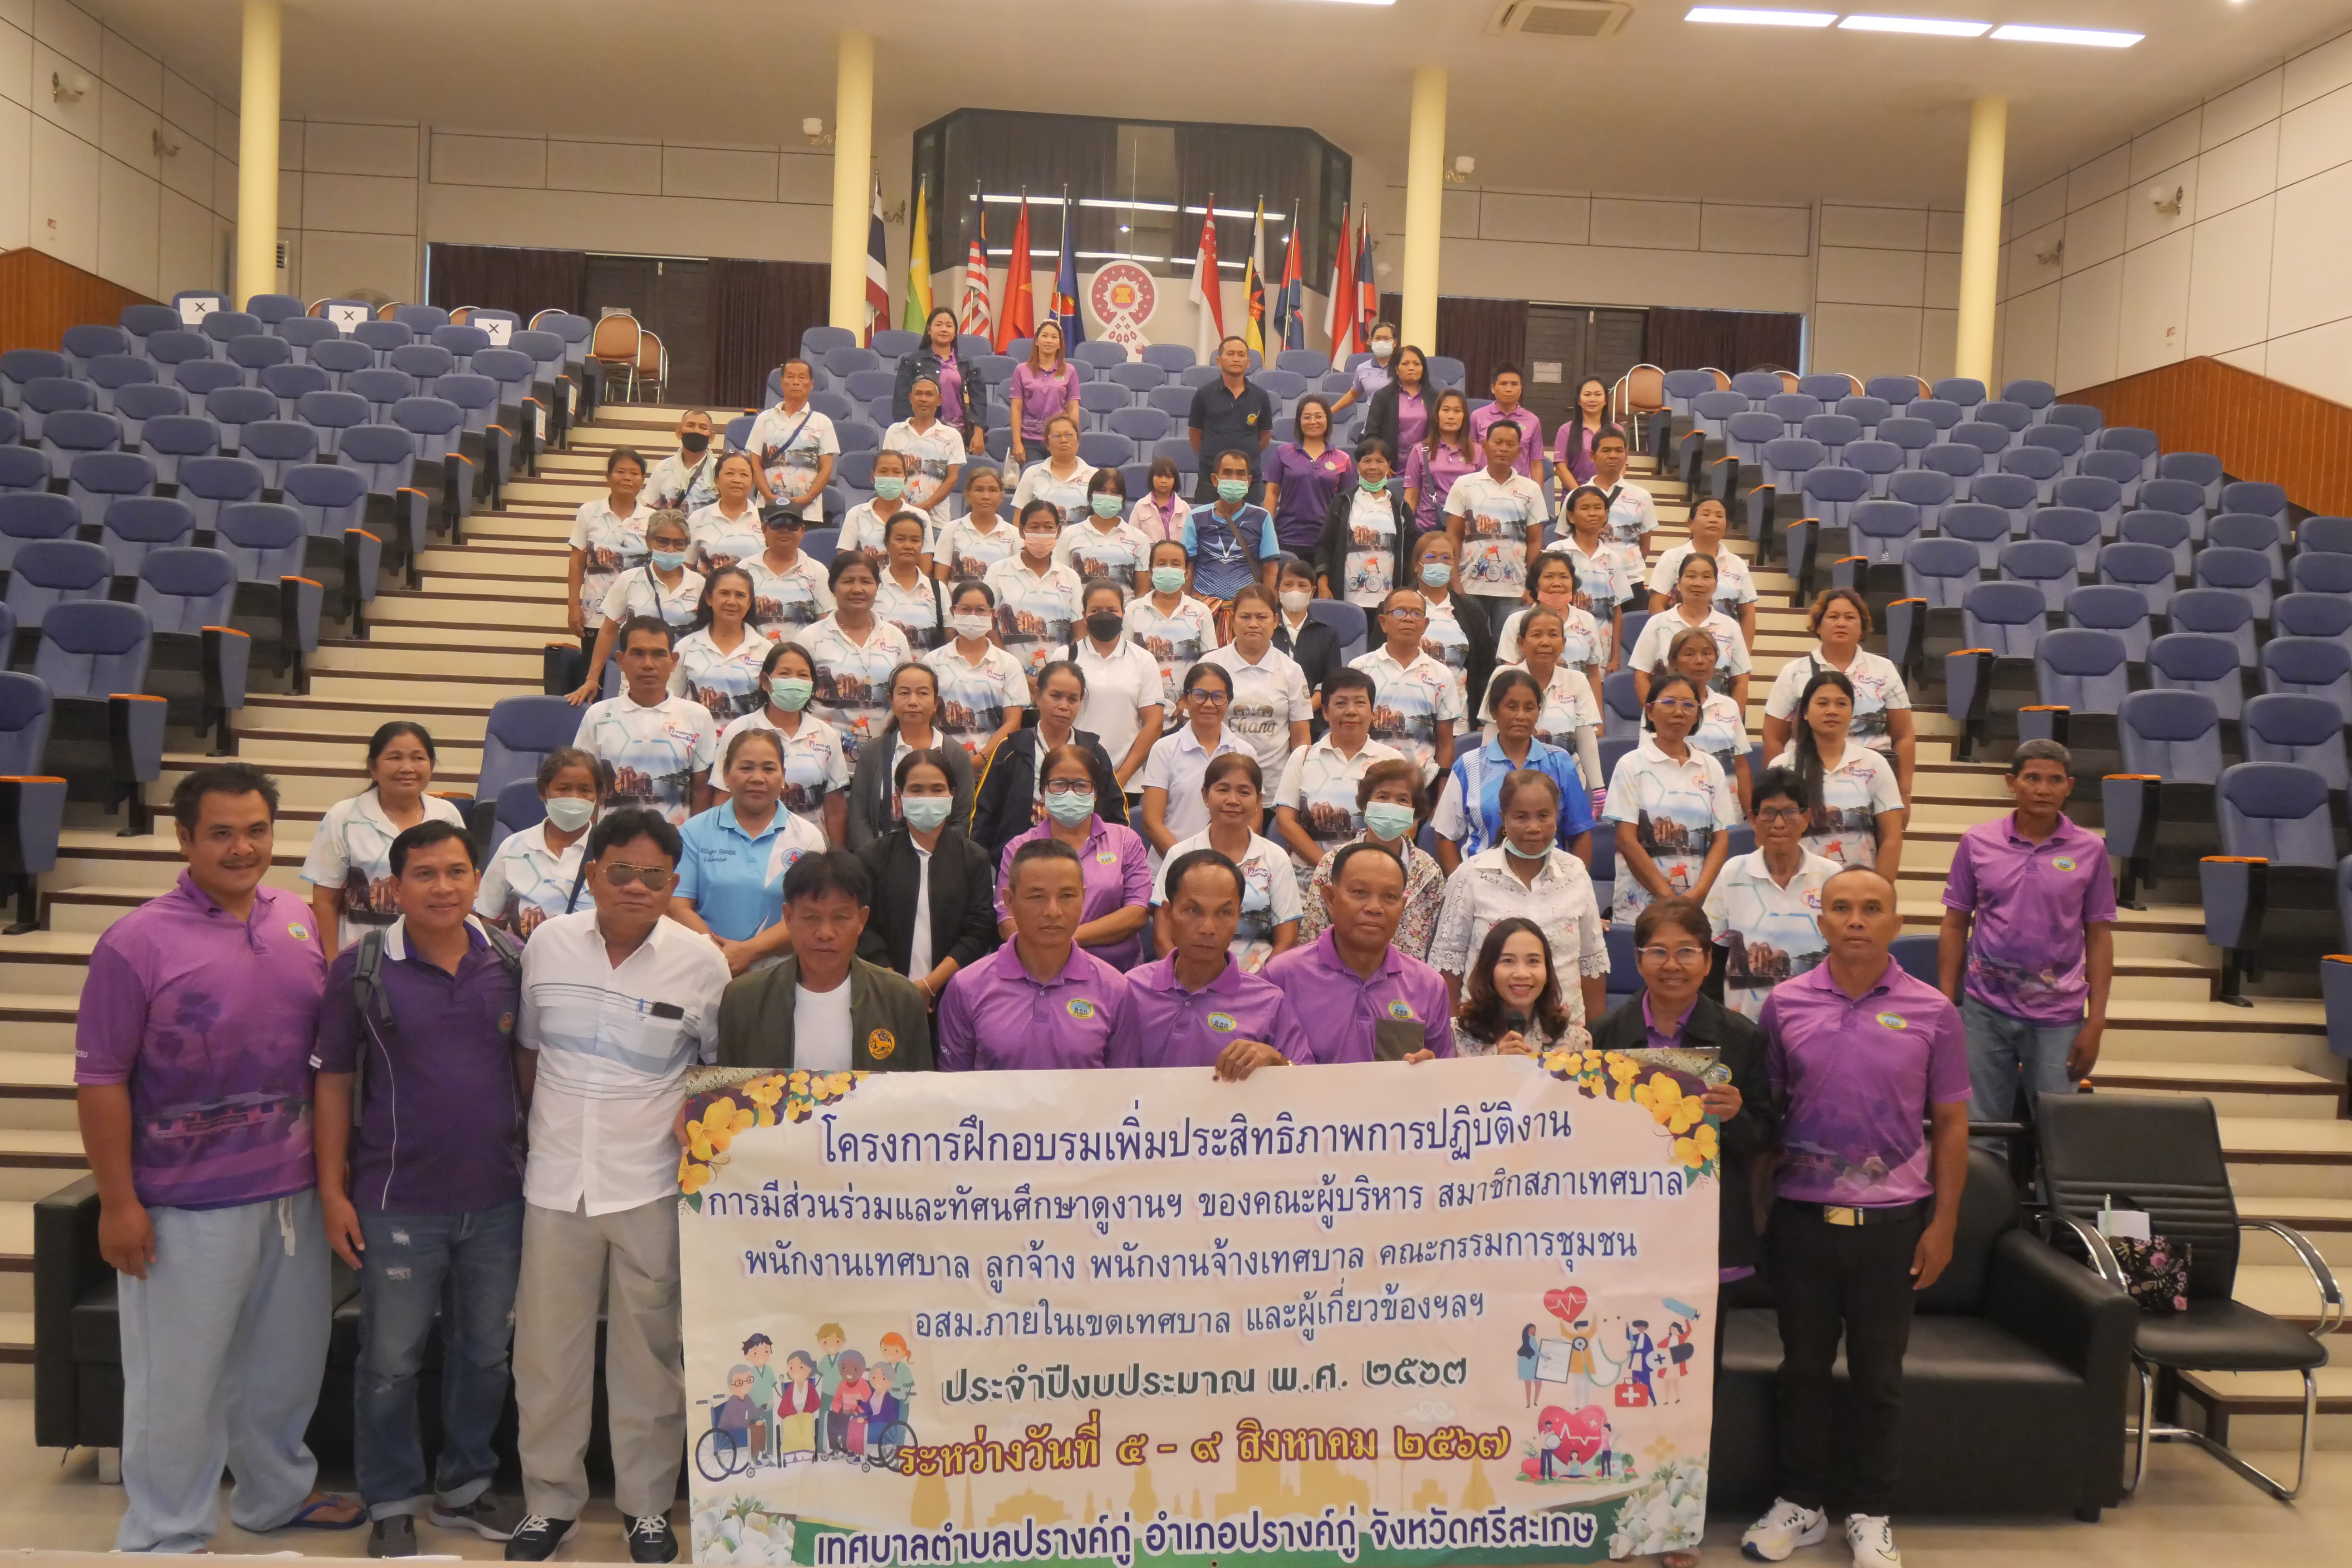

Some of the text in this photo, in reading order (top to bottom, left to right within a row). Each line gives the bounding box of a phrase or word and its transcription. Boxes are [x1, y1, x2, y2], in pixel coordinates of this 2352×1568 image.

[1228, 716, 1277, 737] Chang
[820, 1100, 1572, 1162] โครงการฝึกอบรมเพิ่มประสิทธิภาพการปฏิบัติงาน
[709, 1167, 1682, 1235] การมีส่วนร่วมและทัศนศึกษาดูงานฯ ของคณะผู้บริหาร สมาชิกสภาเทศบาล
[745, 1230, 1637, 1294] พนักงานเทศบาล ลูกจ้าง พนักงานจ้างเทศบาล คณะกรรมการชุมชน
[916, 1277, 1484, 1341] อสม.ภายในเขตเทศบาล และผู้เกี่ยวข้องฯลฯ
[943, 1357, 1467, 1406] ประจำปีงบประมาณ พ.ศ. ๒๕๖๗
[897, 1409, 1101, 1477] ระหว่างวันที่
[1236, 1416, 1378, 1462] สิงหาคม
[1394, 1424, 1512, 1460] ๒๕๖๗
[817, 1506, 1594, 1566] เทศบาลตำบลปรางค์กู่ อำเภอปรางค์กู่ จังหวัดศรีสะเกษ
